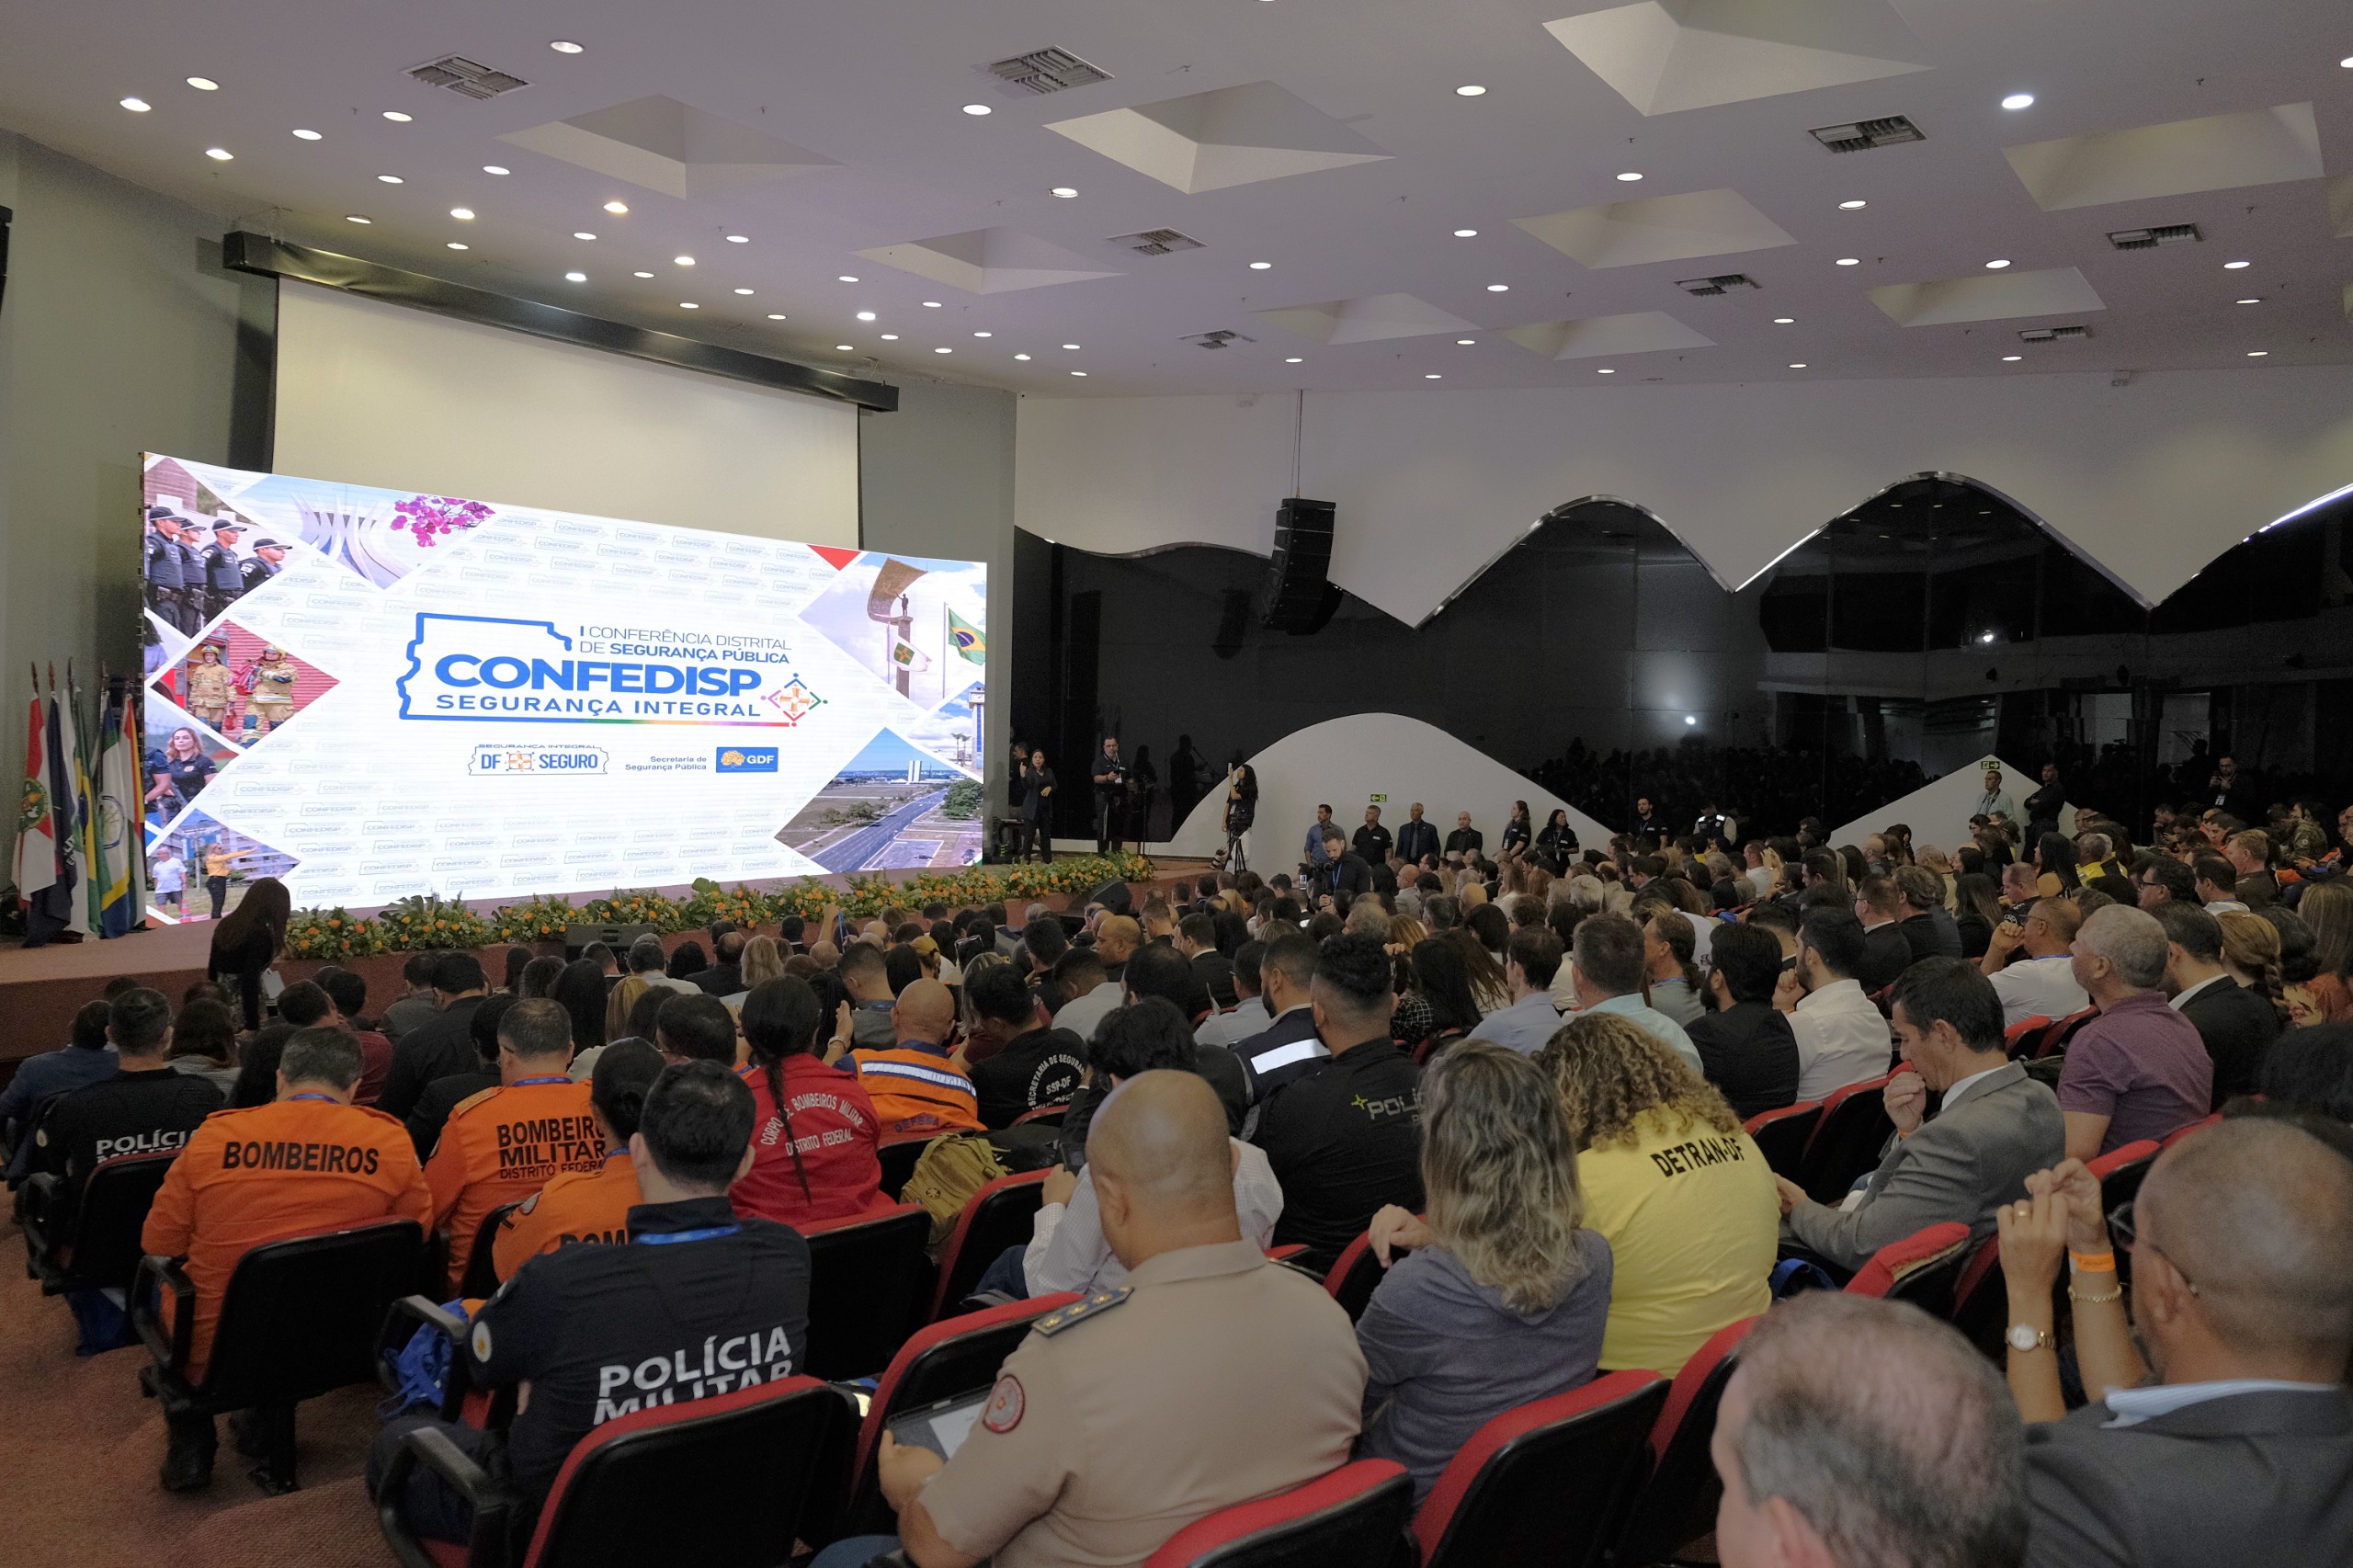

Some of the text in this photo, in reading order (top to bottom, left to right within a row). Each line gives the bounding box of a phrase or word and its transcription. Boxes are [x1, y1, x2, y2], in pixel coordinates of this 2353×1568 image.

[589, 626, 710, 645] CONFERÊNCIA
[715, 635, 792, 650] DISTRITAL
[580, 641, 790, 664] DE SEGURANÇA PÚBLICA
[435, 653, 762, 697] CONFEDISP
[437, 694, 761, 716] SEGURANÇA INTEGRAL
[481, 754, 598, 769] DF SEGURO
[625, 764, 672, 772] Segurança
[746, 755, 774, 765] GDF
[1028, 1060, 1050, 1107] SECRETARIA
[1048, 1054, 1059, 1065] DE
[1045, 1075, 1072, 1096] SSP-DF
[760, 1117, 784, 1145] CORPO
[791, 1093, 837, 1111] BOMBEIROS
[838, 1099, 864, 1128] MILITAR
[96, 1129, 197, 1155] POLÍCI
[496, 1116, 605, 1148] BOMBEIR
[822, 1128, 854, 1146] FEDERAL
[222, 1142, 380, 1175] BOMBEIROS
[499, 1140, 606, 1167] MILITAR
[1651, 1137, 1745, 1177] DETRAN-DF
[500, 1165, 556, 1179] DISTRITO
[598, 1325, 792, 1398] POLÍCIA
